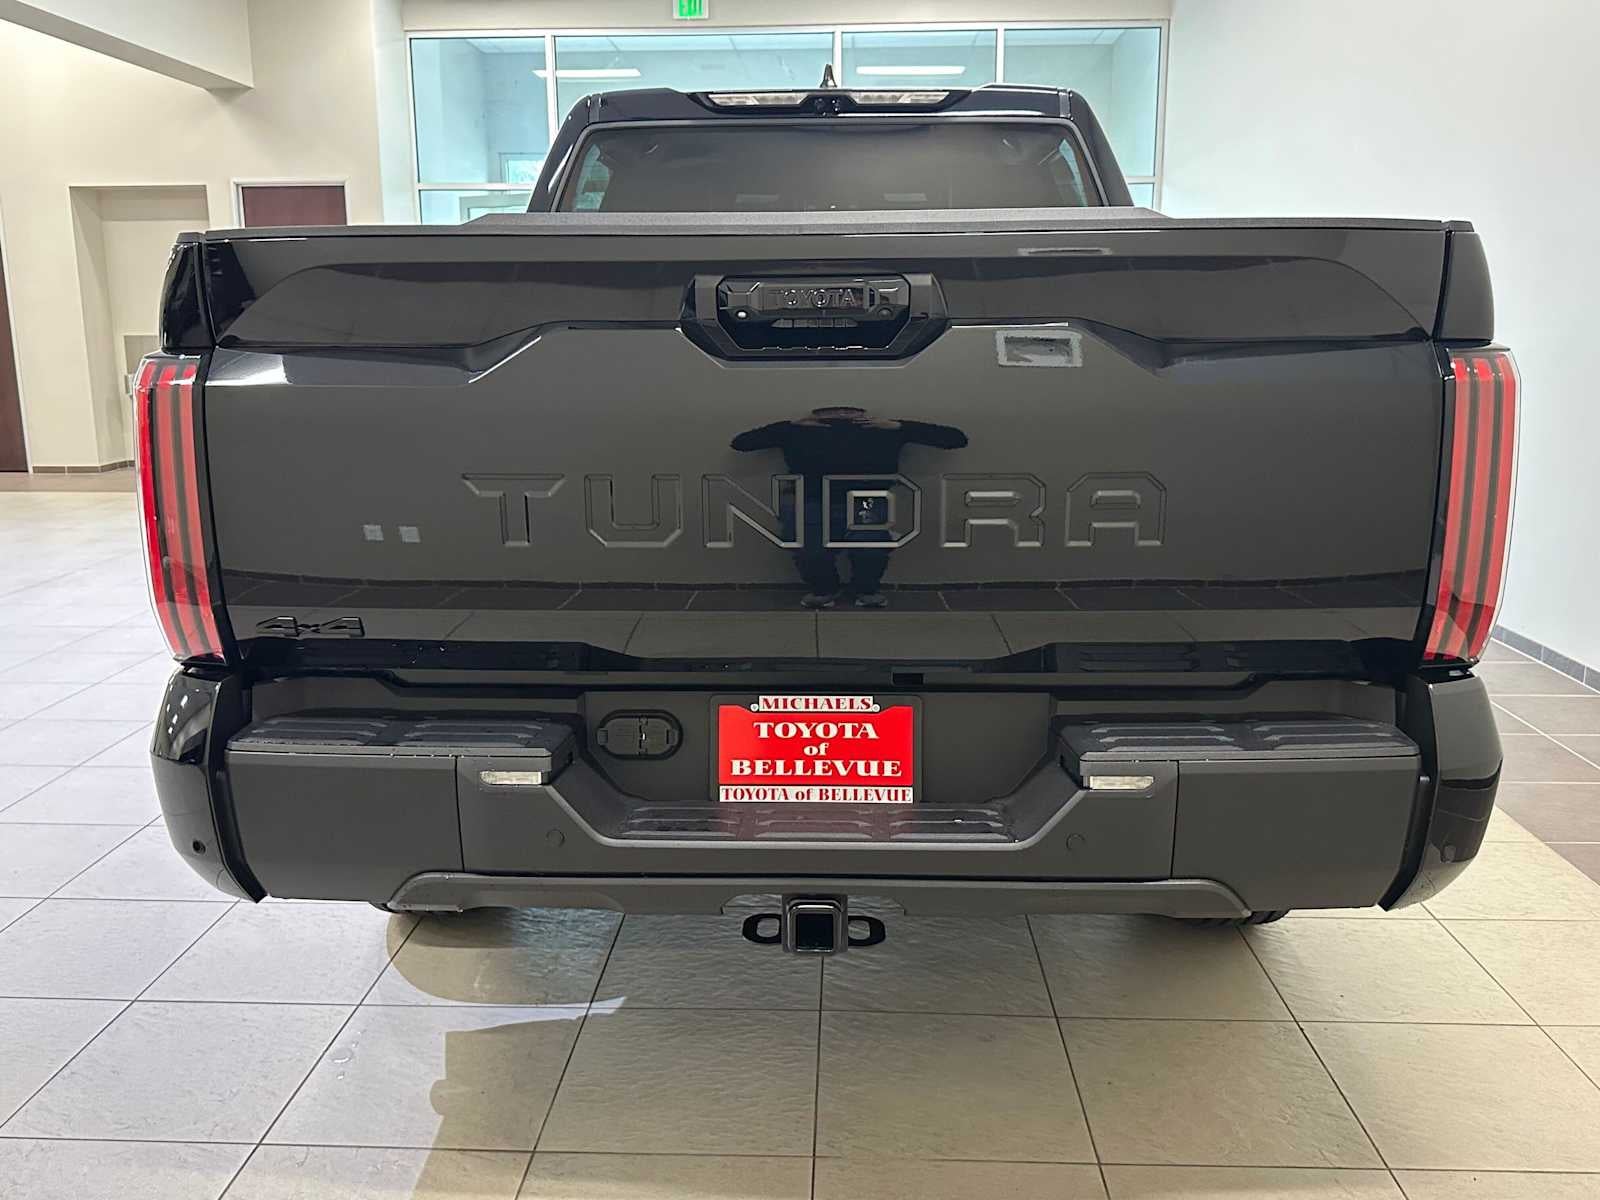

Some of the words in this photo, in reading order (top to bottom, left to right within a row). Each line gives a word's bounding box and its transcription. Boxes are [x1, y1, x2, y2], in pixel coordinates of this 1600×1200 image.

[767, 287, 858, 309] TOYOTA
[462, 472, 1167, 548] TUNDRA
[761, 697, 872, 710] MICHAELS
[753, 721, 880, 739] TOYOTA
[803, 742, 830, 756] of
[730, 759, 902, 777] BELLEVUE
[721, 787, 790, 801] TOYOTA
[795, 787, 815, 801] of
[819, 788, 912, 802] BELLEVUE
